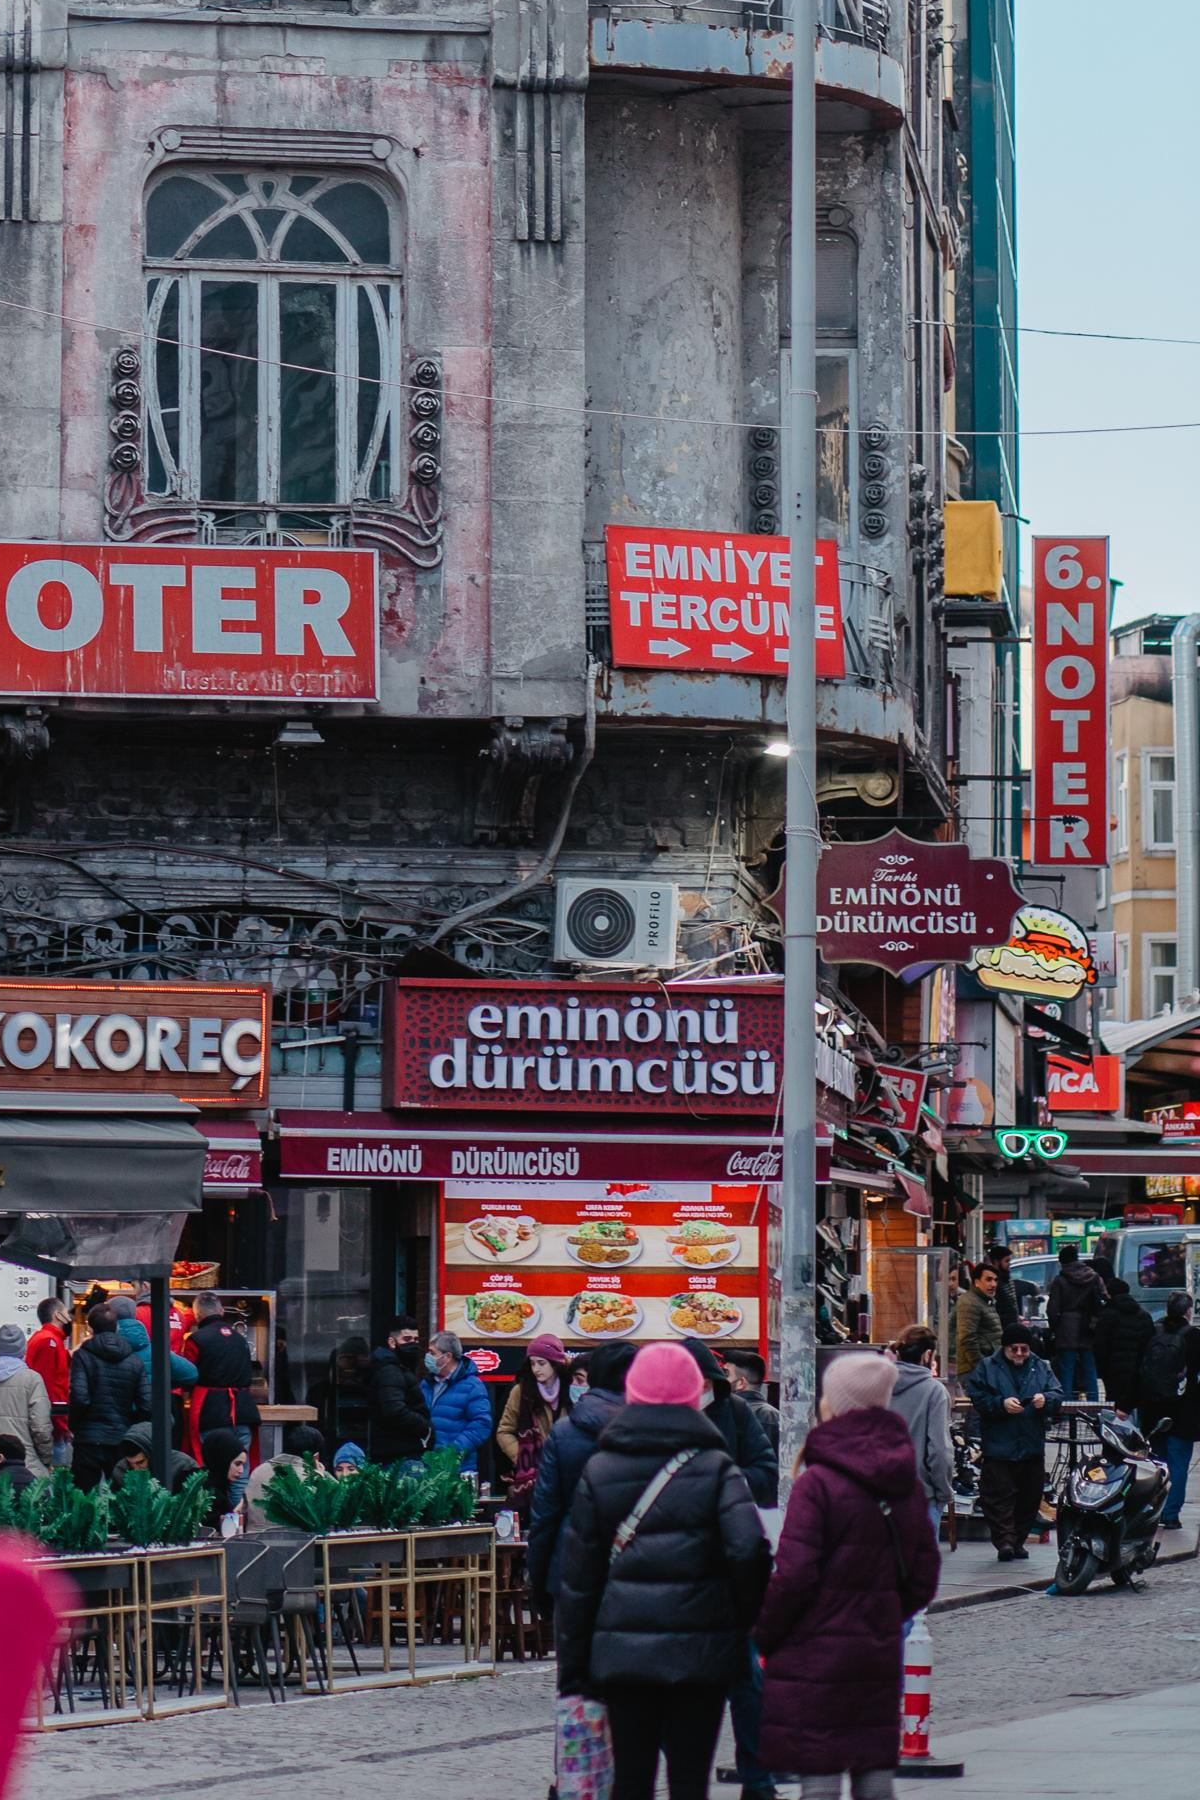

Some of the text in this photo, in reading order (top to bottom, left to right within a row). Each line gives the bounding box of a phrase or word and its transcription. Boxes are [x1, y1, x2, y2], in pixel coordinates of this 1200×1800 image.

[625, 540, 824, 588] EMNİYE
[1044, 544, 1102, 859] 6. NOTER
[829, 883, 961, 906] EMİNÖNÜ
[872, 868, 918, 882] Tarihi
[816, 911, 977, 934] DÜRÜMCÜSÜ
[468, 997, 739, 1045] eminönü
[429, 1038, 776, 1096] dürümcüsü
[327, 1143, 580, 1176] EMİNÖNÜ DÜRÜMCÜSÜ
